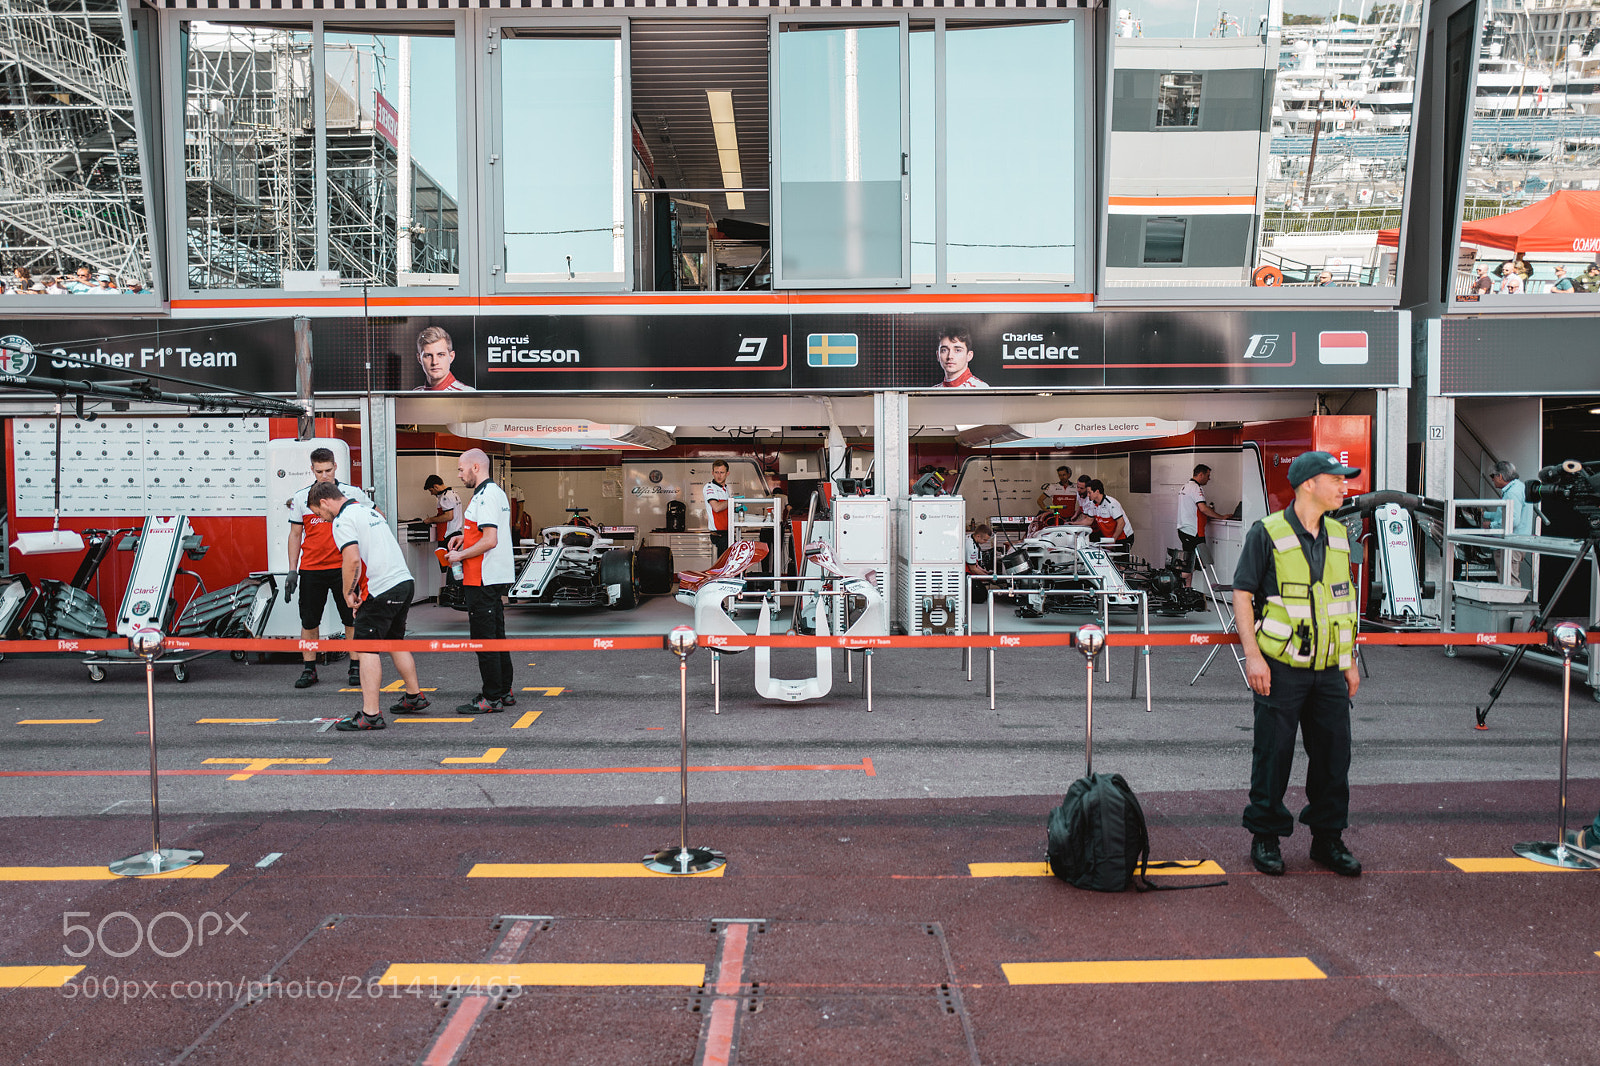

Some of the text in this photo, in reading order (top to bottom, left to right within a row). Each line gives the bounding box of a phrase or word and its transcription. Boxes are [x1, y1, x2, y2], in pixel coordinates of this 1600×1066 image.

[487, 335, 530, 345] Marcus
[1002, 332, 1044, 342] Charles
[735, 337, 768, 362] 9
[1243, 334, 1279, 359] 16
[487, 346, 580, 363] Ericsson
[1002, 344, 1079, 360] Leclerc
[51, 348, 134, 369] Sauber
[175, 348, 237, 368] Team
[504, 424, 534, 433] Marcus
[536, 424, 573, 433] Ericsson
[1074, 423, 1107, 432] Charles
[1108, 423, 1140, 432] Leclerc
[1431, 428, 1442, 438] 12
[652, 485, 680, 495] Romeo
[1085, 551, 1105, 560] 16
[134, 586, 156, 595] Claro
